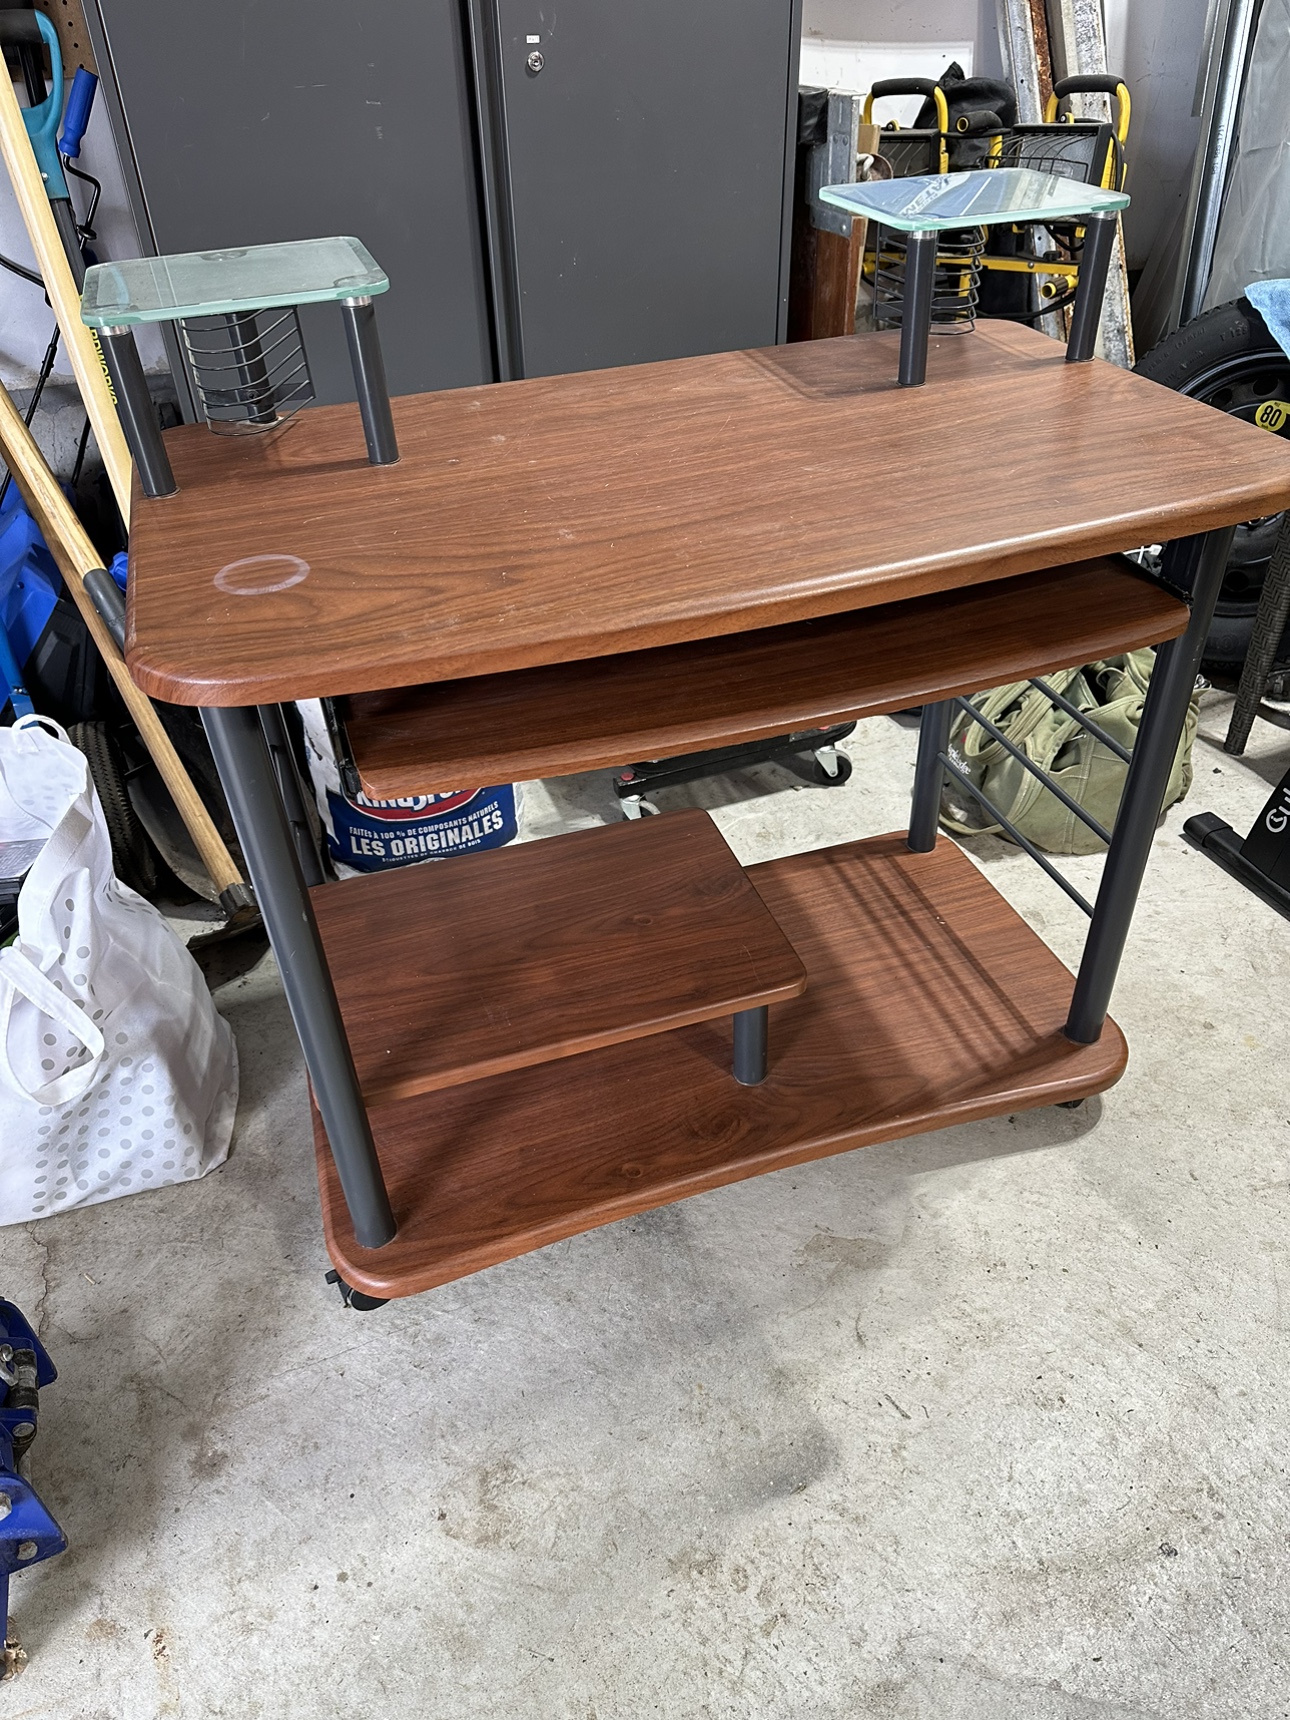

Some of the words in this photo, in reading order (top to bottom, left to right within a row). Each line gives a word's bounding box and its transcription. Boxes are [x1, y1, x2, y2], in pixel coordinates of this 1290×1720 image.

[1260, 405, 1282, 427] 80
[349, 826, 372, 838] FAITES
[380, 831, 395, 839] 100
[407, 828, 417, 836] DE
[418, 817, 467, 834] COMPOSANTS
[468, 801, 499, 822] NATURELS
[350, 836, 386, 856] LES
[390, 810, 504, 856] ORIGINALES
